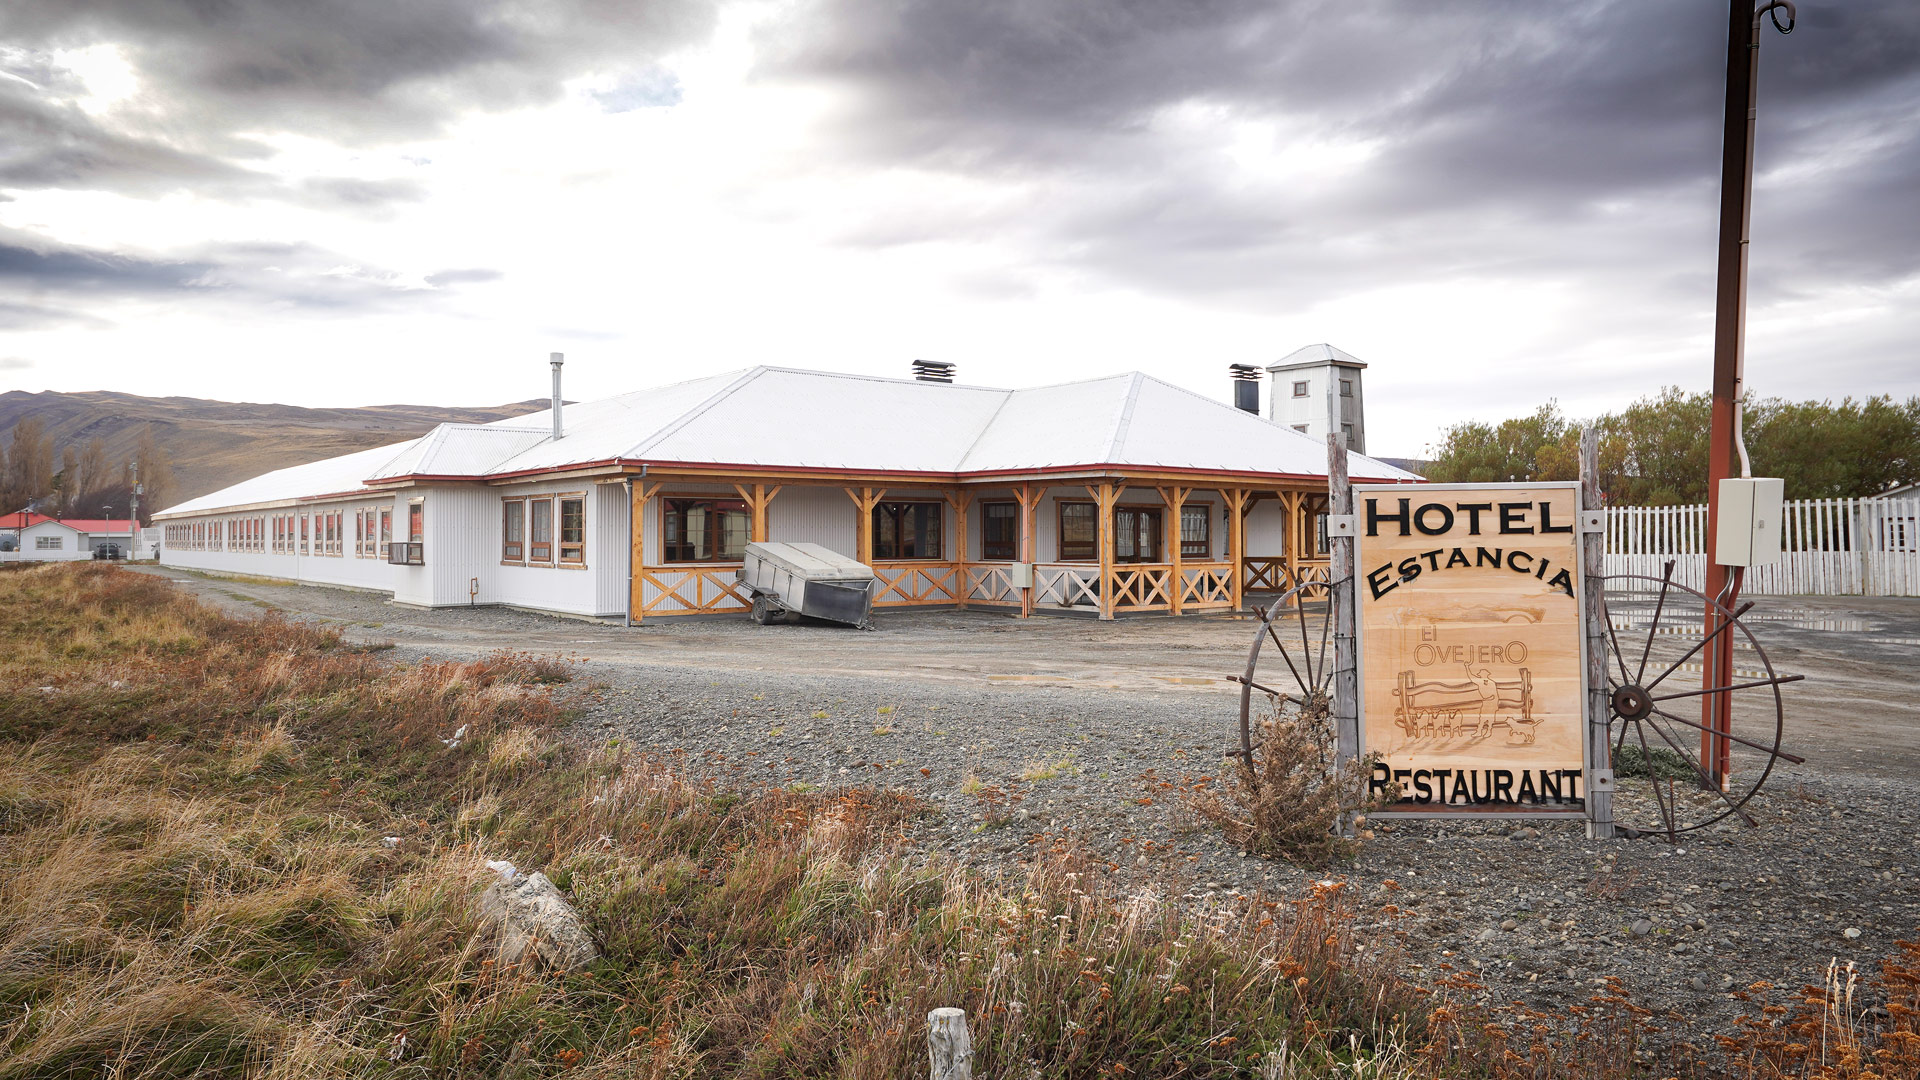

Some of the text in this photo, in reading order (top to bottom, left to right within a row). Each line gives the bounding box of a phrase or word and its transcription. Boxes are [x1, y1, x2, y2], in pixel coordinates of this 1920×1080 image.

[1365, 498, 1574, 537] HOTEL
[1367, 547, 1575, 601] ESTANCIA
[1414, 641, 1528, 667] OVEJERO
[1368, 763, 1582, 804] RESTAURANT
